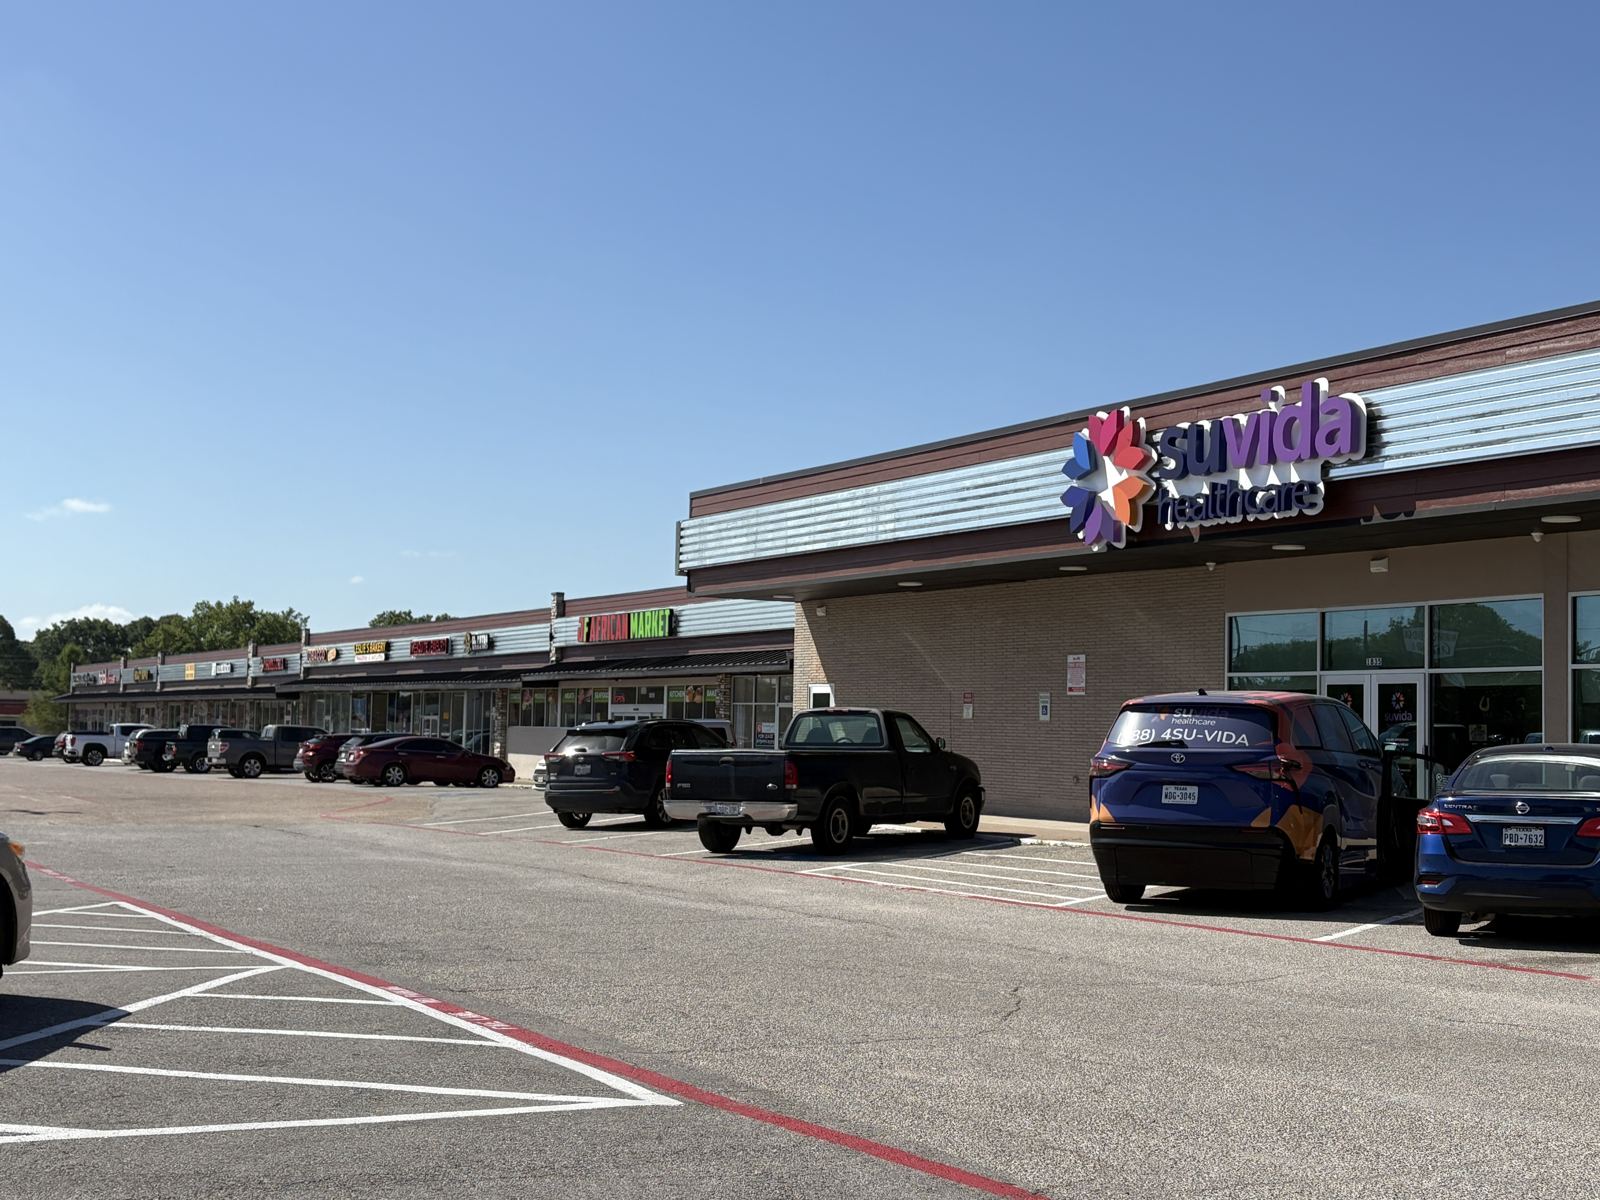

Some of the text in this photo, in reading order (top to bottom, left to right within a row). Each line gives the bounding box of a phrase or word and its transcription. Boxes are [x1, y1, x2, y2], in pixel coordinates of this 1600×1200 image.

[1159, 378, 1354, 481] suvida
[1156, 478, 1319, 525] healthcare
[589, 613, 629, 642] AFRICAN
[630, 608, 670, 639] MARKET
[1171, 717, 1216, 726] healthcare
[1384, 710, 1413, 721] suvida
[1160, 728, 1250, 747] 4SU-VIDA
